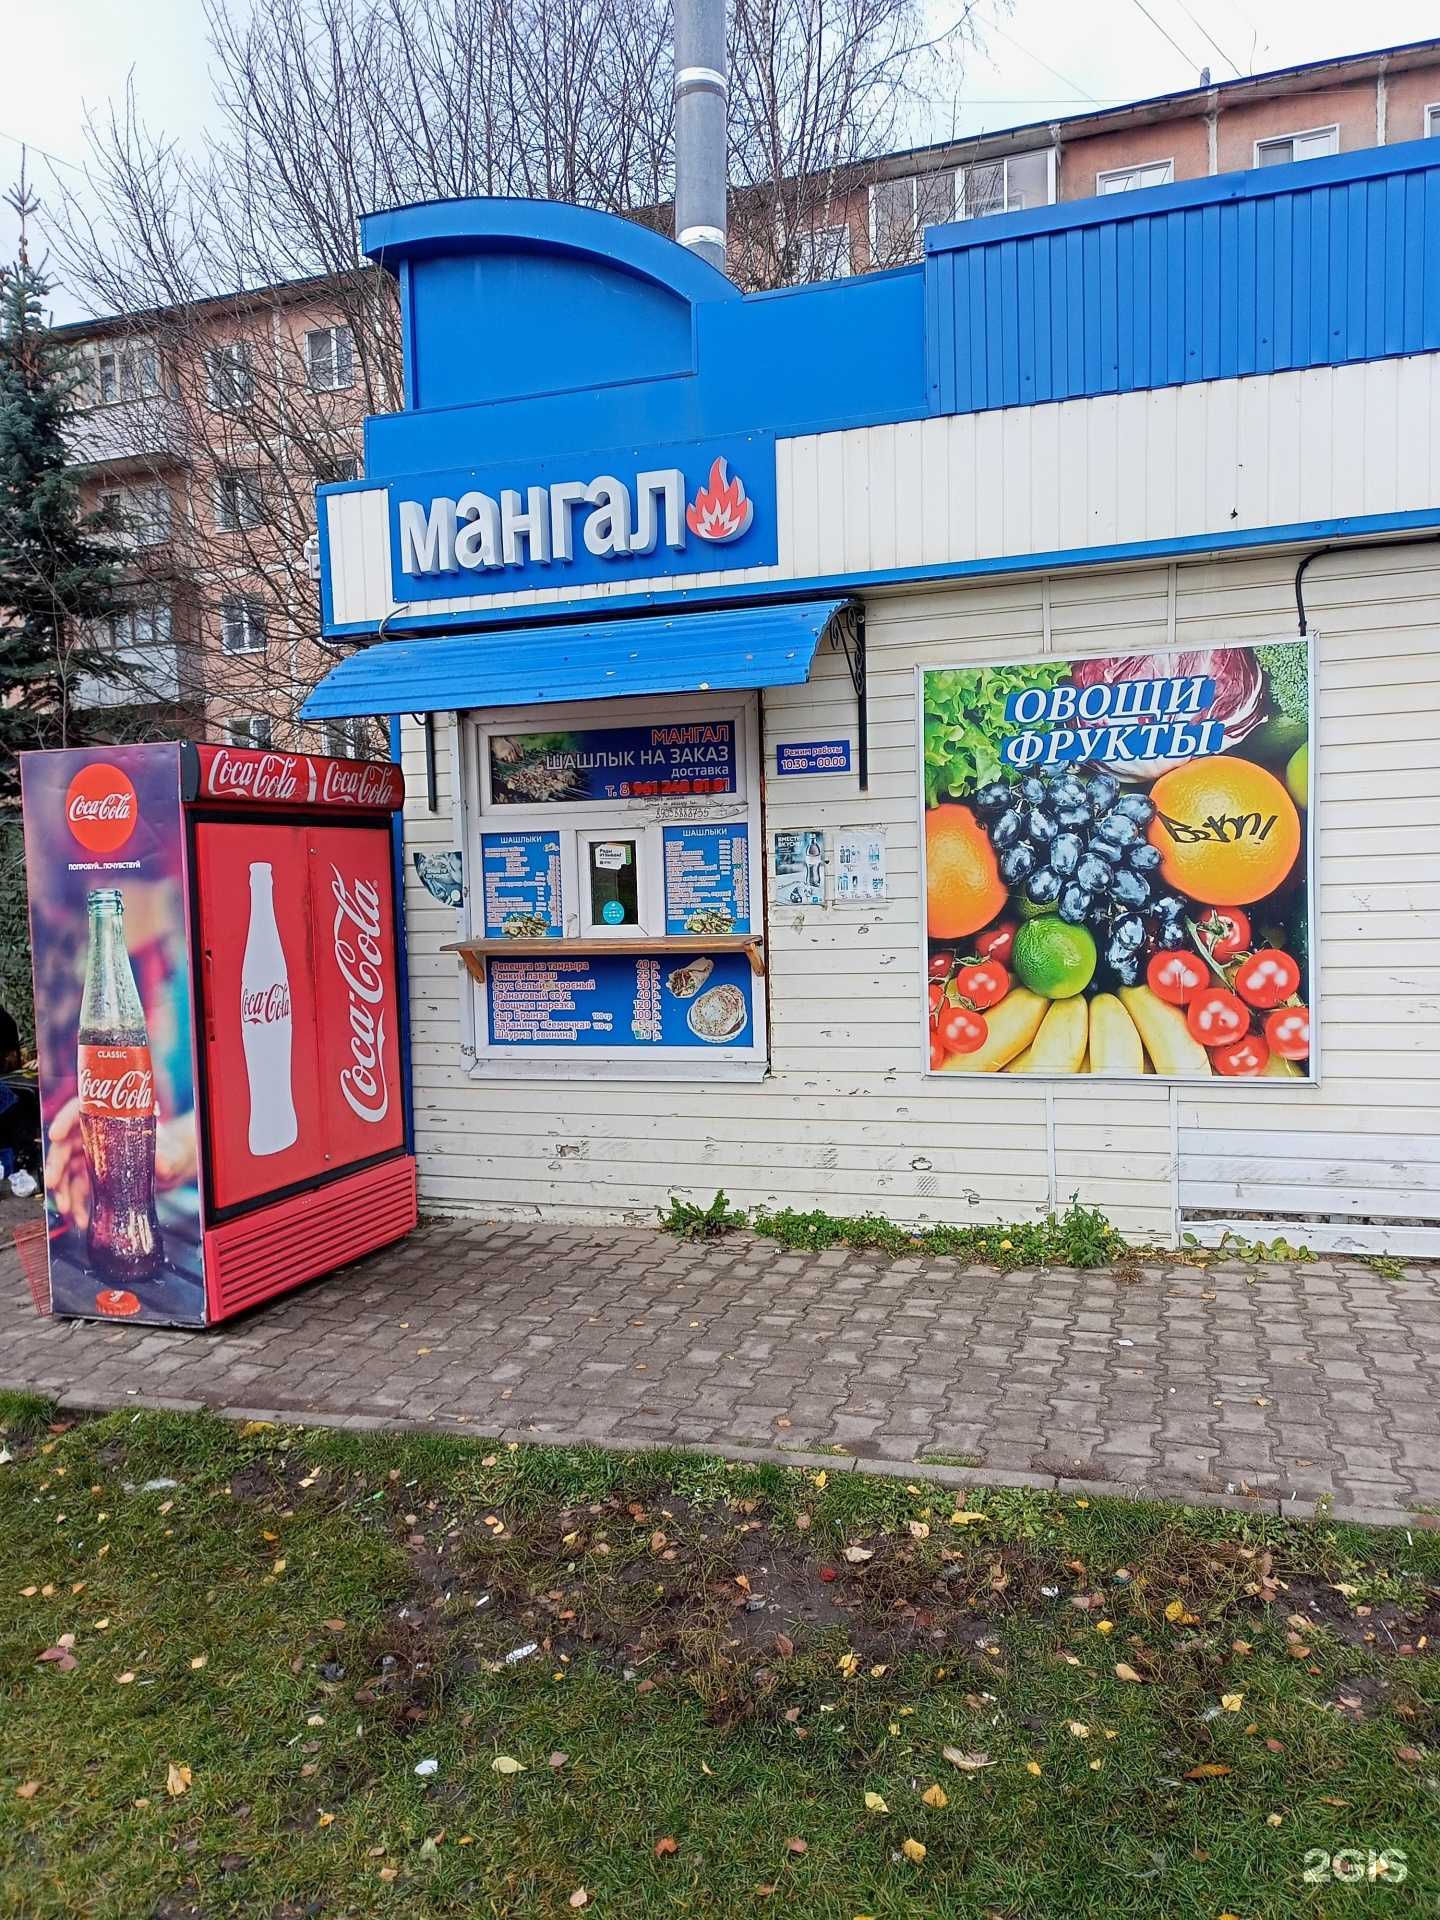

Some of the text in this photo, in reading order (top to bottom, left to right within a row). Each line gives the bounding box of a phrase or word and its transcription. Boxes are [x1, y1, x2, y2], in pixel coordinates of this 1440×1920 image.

[1013, 675, 1209, 724] ОВОЩИ
[651, 725, 729, 746] МАНГАЛ
[1006, 719, 1223, 769] ФРУКТЫ
[783, 746, 843, 757] Режим работы
[546, 746, 729, 770] ШАШЛЫК НА ЗАКАЗ
[207, 749, 298, 800] Coca-Cola
[671, 765, 729, 778] доставка
[323, 761, 394, 806] Coca-Cola
[69, 793, 132, 822] Coca-Cola
[683, 828, 728, 836] ШАШЛЫКИ
[500, 836, 542, 844] ШАШЛЫКИ
[636, 960, 650, 969] 40
[637, 970, 650, 979] 25
[493, 981, 514, 991] Соус
[553, 979, 596, 991] красный
[329, 862, 389, 1123] Coca-Cola
[549, 991, 572, 1001] соус
[537, 1001, 576, 1011] нарезка
[493, 1011, 513, 1021] Сыр
[514, 1010, 549, 1021] Брынза
[494, 1020, 539, 1030] Баранина
[494, 1030, 532, 1041] Шаурма
[97, 1050, 128, 1059] CLASSIC
